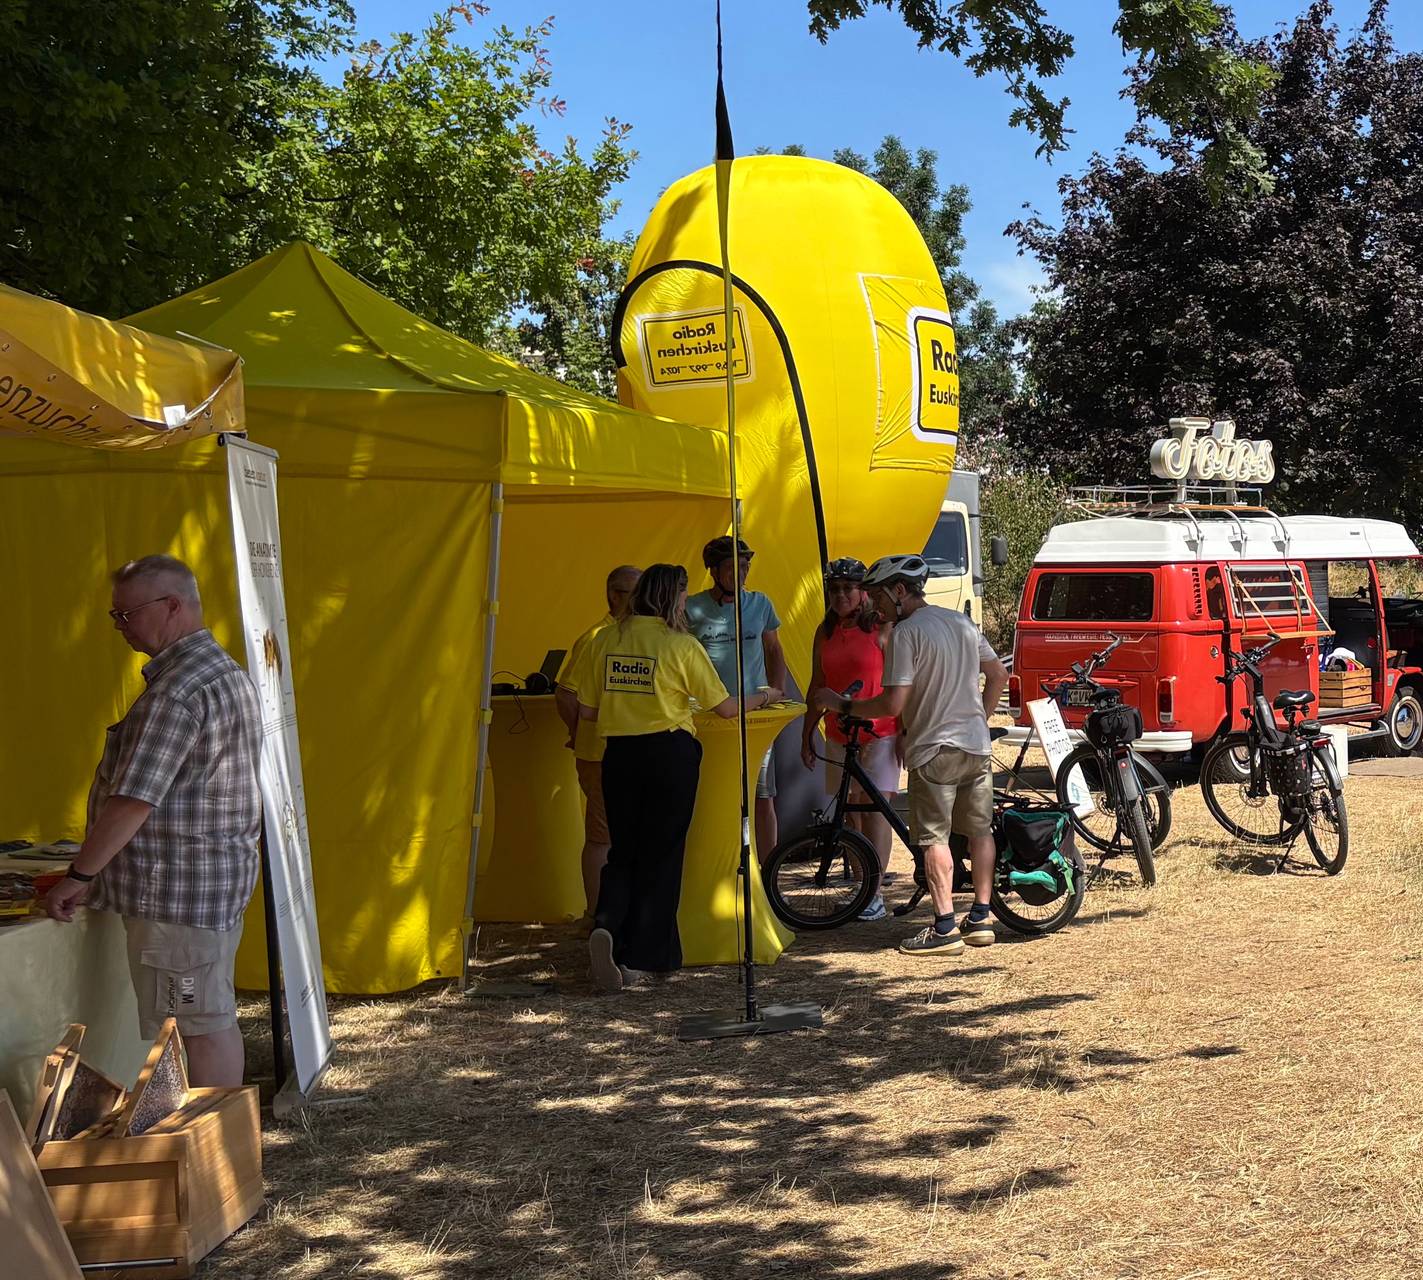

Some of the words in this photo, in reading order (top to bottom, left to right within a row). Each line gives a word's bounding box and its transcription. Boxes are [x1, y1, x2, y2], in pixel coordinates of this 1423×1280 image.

[1152, 416, 1275, 484] Fotos
[612, 661, 650, 675] Radio
[609, 675, 652, 687] Euskirchen
[182, 976, 195, 1005] DNM
